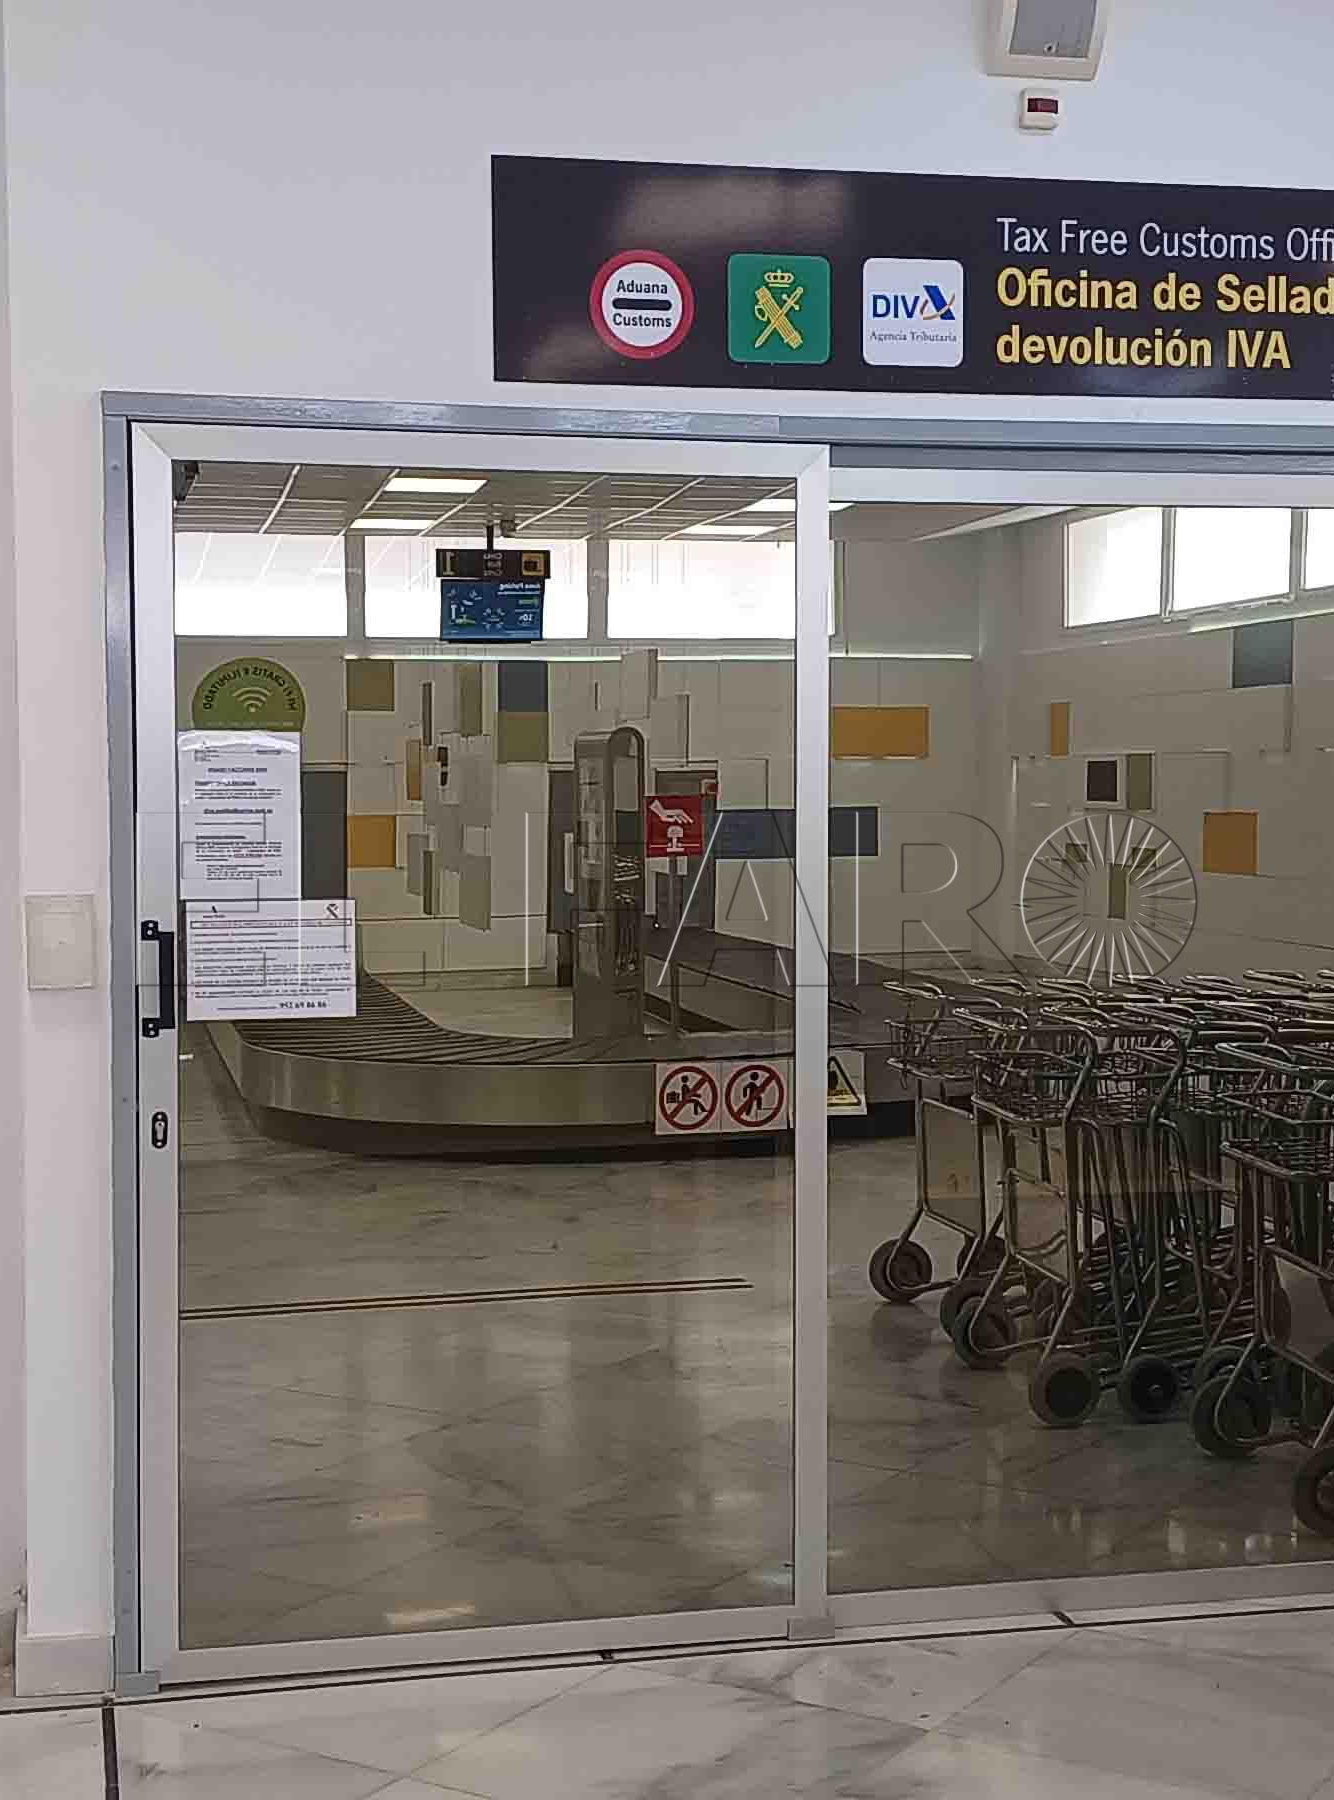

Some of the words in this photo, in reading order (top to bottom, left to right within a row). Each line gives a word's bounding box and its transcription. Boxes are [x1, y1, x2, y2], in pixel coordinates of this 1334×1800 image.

[996, 217, 1049, 254] Tax
[1060, 219, 1128, 256] Free
[1139, 222, 1275, 261] Customs
[616, 280, 668, 295] Aduana
[997, 267, 1138, 310] Oficina
[1153, 272, 1202, 311] de
[613, 313, 672, 328] Customs
[869, 330, 907, 344] Agencia
[910, 331, 957, 343] Tributaria
[996, 323, 1213, 368] devolución
[1227, 329, 1291, 369] IVA
